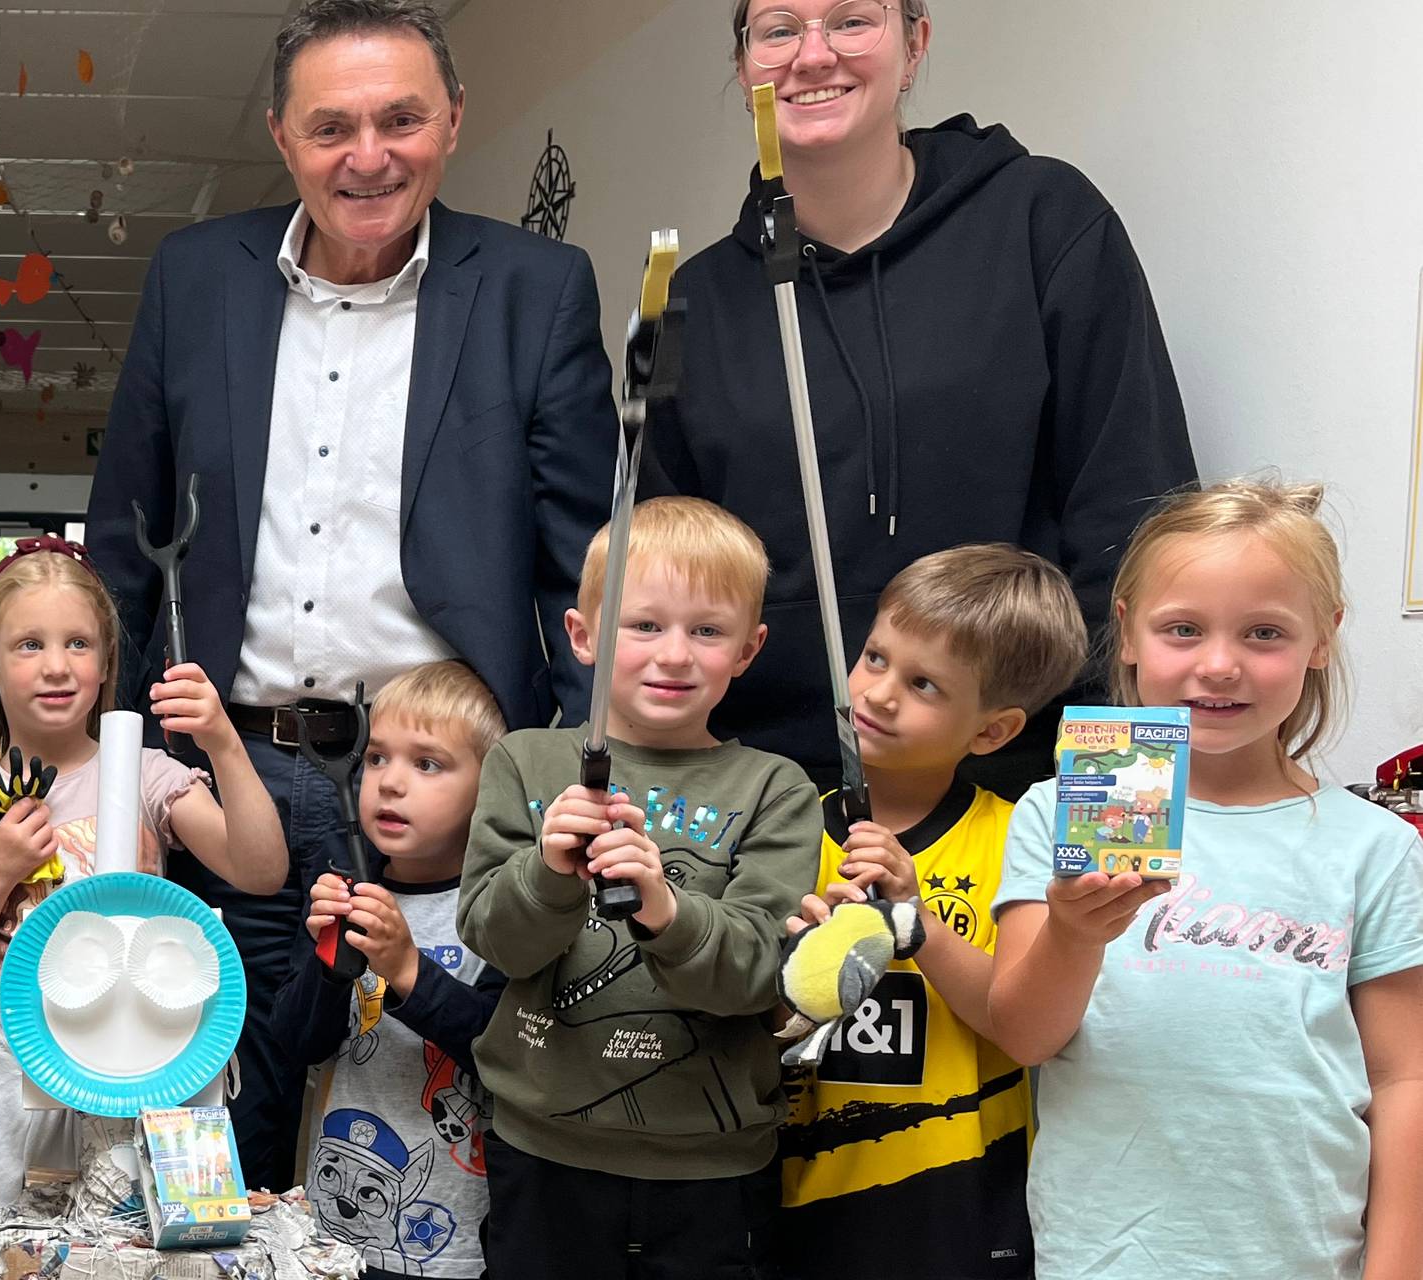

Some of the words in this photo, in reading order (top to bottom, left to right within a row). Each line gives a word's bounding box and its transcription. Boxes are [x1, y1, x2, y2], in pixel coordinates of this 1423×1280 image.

[1065, 724, 1129, 735] GARDENING
[1137, 727, 1186, 740] PACIFIC
[1074, 734, 1116, 745] GLOVES
[1056, 846, 1087, 859] XXXS
[1060, 860, 1067, 869] 3
[931, 899, 970, 938] VB
[613, 1028, 657, 1041] Massive
[607, 1038, 637, 1050] Skull
[638, 1039, 662, 1051] with
[601, 1047, 629, 1059] thick
